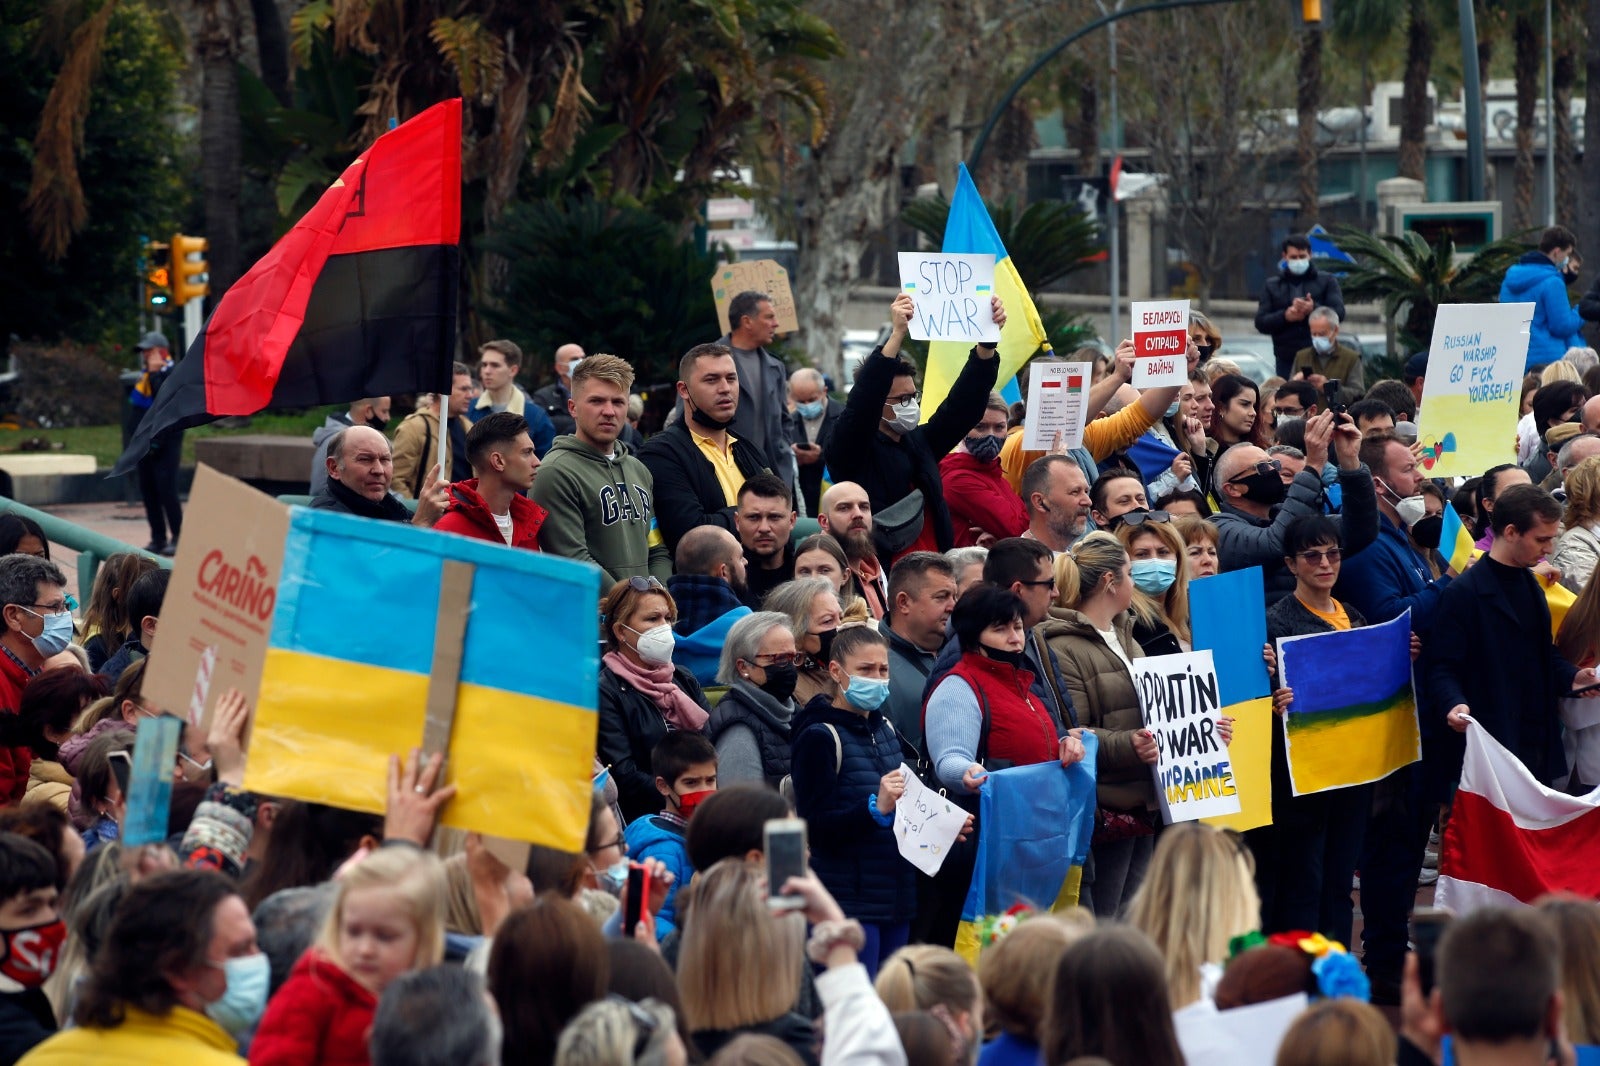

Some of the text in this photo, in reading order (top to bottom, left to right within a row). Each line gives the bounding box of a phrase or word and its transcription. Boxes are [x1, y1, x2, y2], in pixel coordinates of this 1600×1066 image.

[919, 260, 972, 295] STOP
[916, 297, 984, 337] WAR
[1143, 311, 1183, 325] БЕЛАРУСЫ
[1145, 336, 1180, 351] СУПРАЦЬ
[1443, 332, 1482, 350] RUSSIAN
[1463, 346, 1497, 365] WARSHIP,
[1147, 358, 1175, 375] ВАЙНЫ
[1449, 364, 1464, 384] GO
[1468, 381, 1514, 404] YOURSELF!
[599, 482, 650, 526] GAP
[197, 548, 276, 622] CARIÑO
[1166, 717, 1219, 759] WAR
